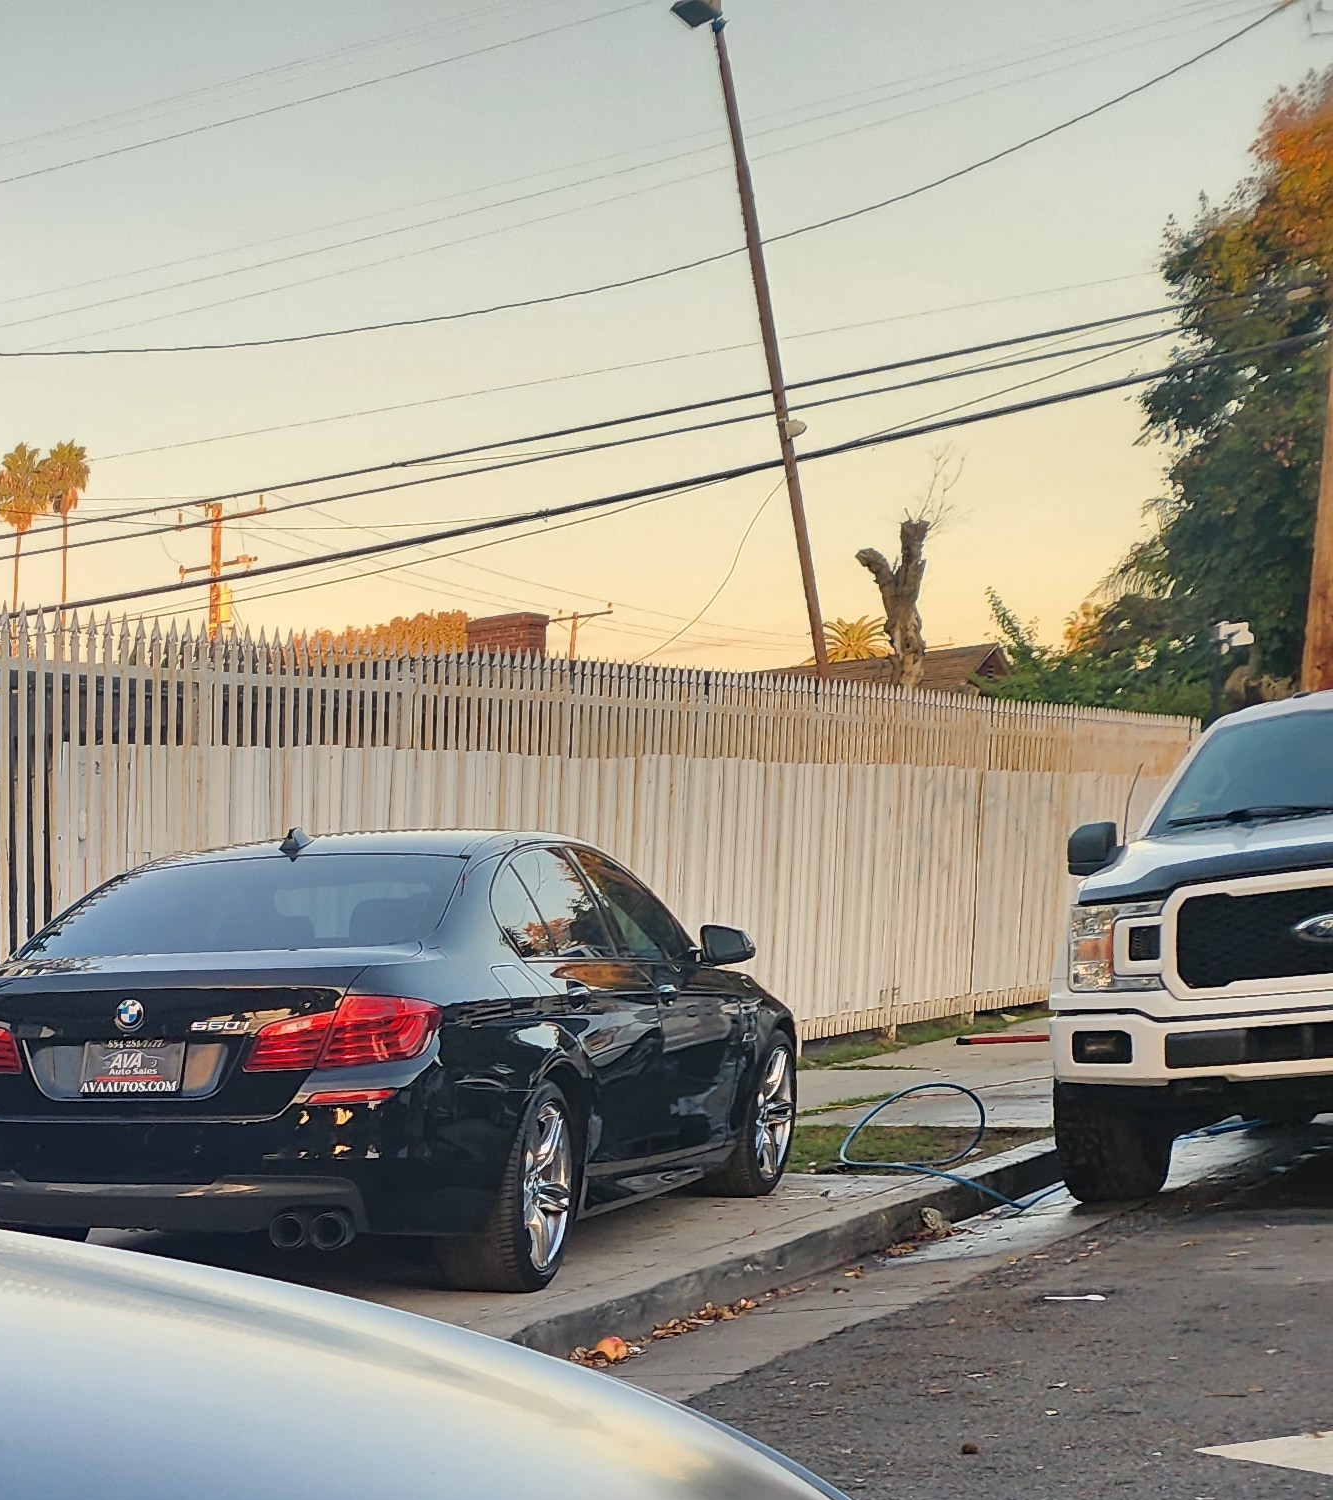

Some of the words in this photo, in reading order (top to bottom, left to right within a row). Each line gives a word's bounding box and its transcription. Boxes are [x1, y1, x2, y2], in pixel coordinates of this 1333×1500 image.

[109, 1052, 144, 1069] AVA
[108, 1068, 131, 1076] Auto
[133, 1066, 158, 1075] Sales
[79, 1080, 178, 1093] AVAAUTOS.COM
